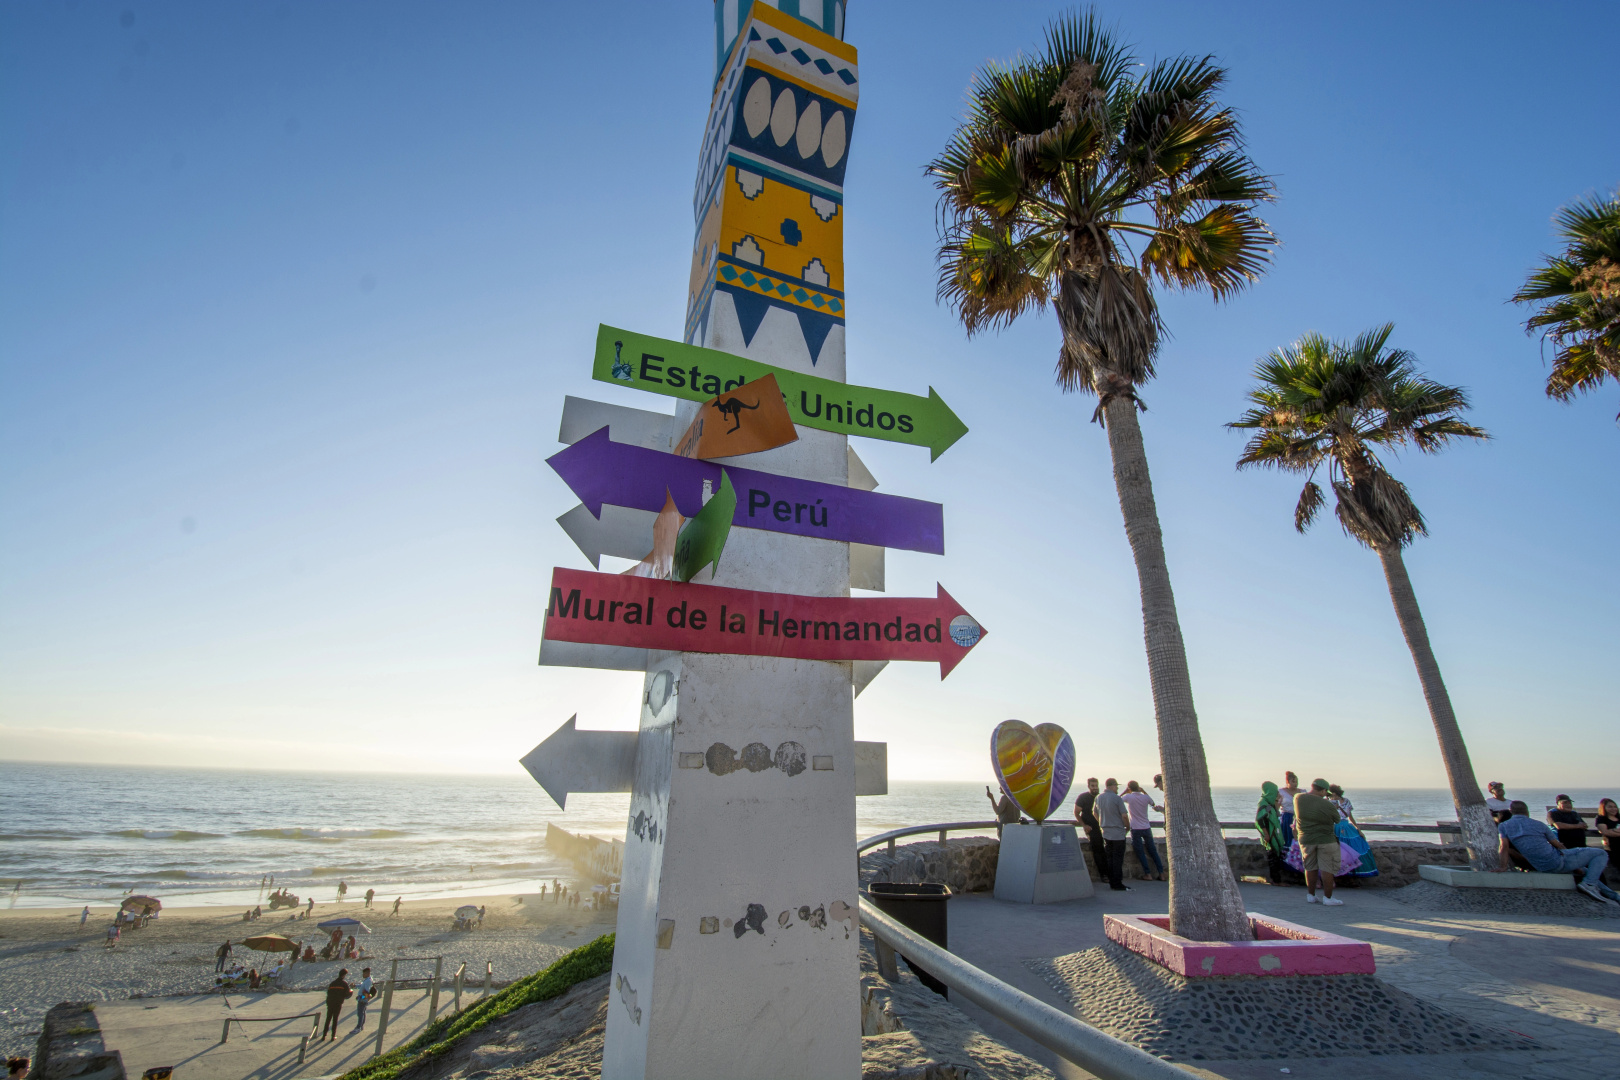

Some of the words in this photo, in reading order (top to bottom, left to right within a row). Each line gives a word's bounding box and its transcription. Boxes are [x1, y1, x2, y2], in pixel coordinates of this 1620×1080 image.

[639, 353, 787, 407] Estad
[800, 390, 914, 434] Unidos
[748, 488, 828, 528] Perú
[548, 587, 655, 626] Mural
[666, 600, 708, 631] de
[719, 604, 746, 634] la
[758, 608, 942, 643] Hermandad
